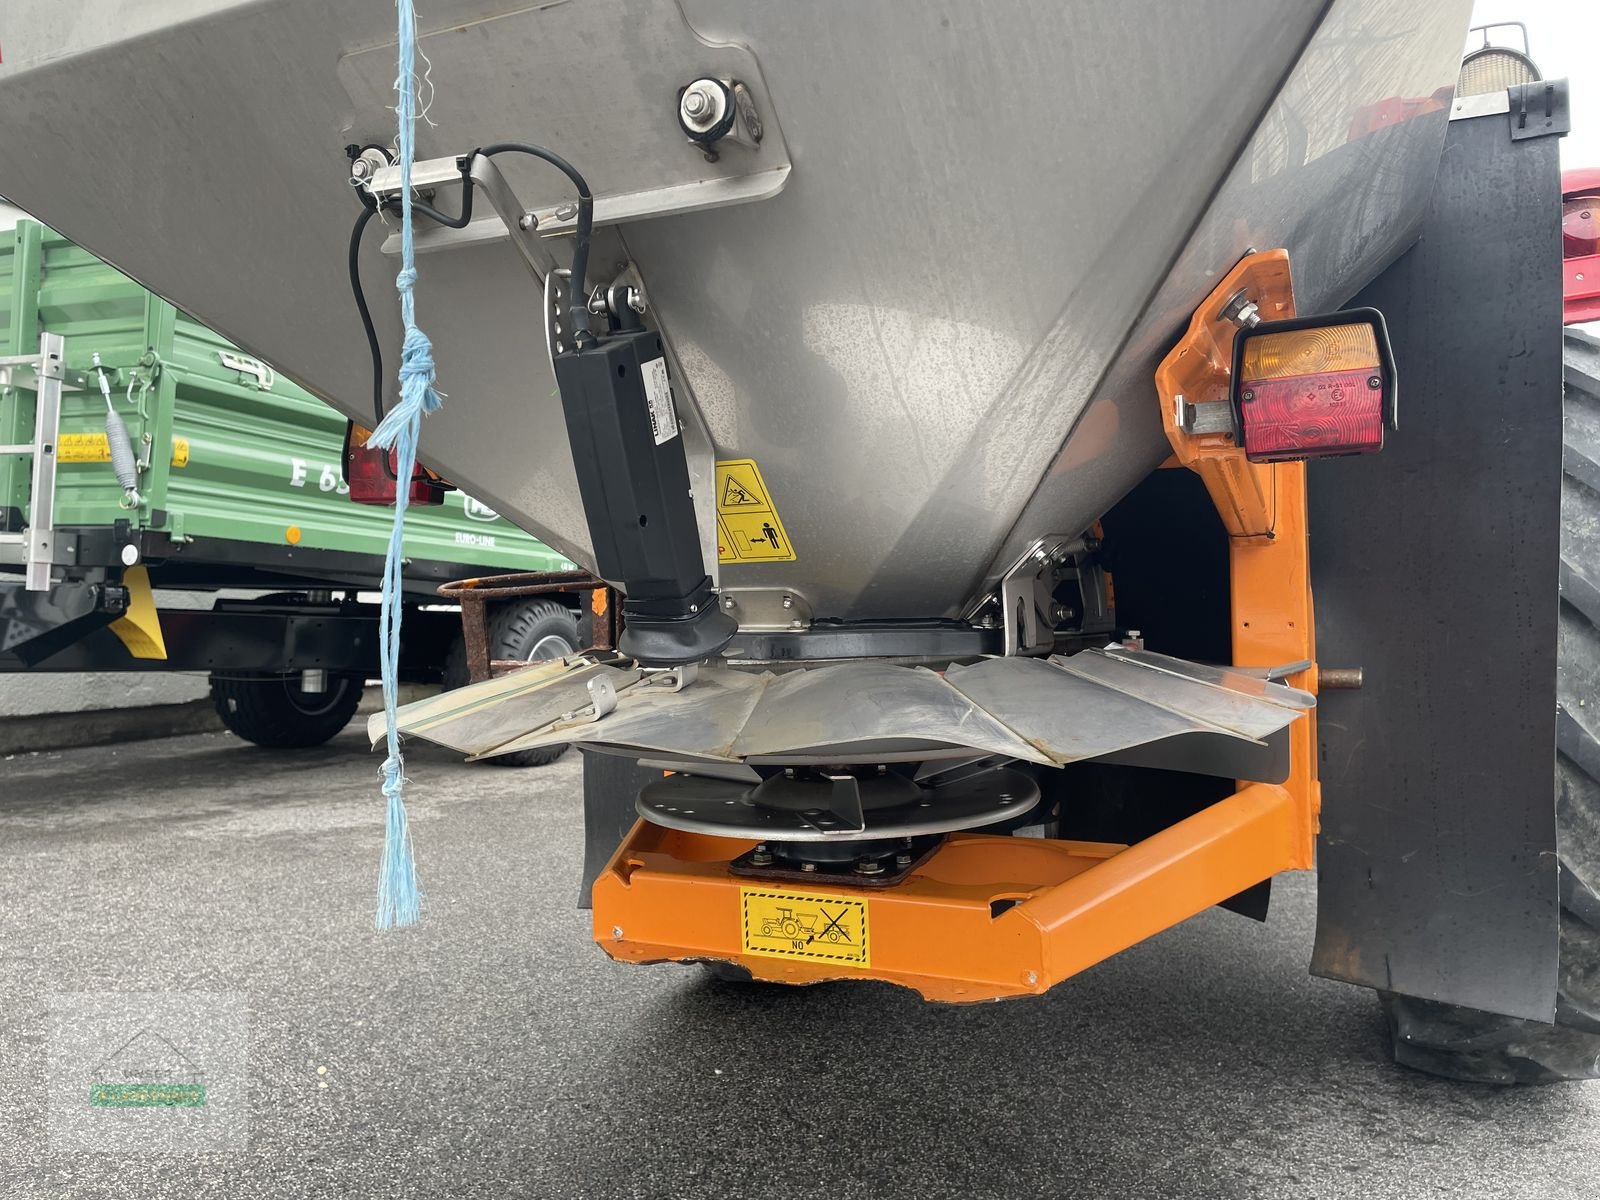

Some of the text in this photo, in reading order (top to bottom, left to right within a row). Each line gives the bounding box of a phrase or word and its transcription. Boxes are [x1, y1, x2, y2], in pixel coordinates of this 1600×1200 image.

[289, 458, 307, 488] E
[455, 532, 496, 548] EURO-LINE
[792, 940, 804, 950] NO
